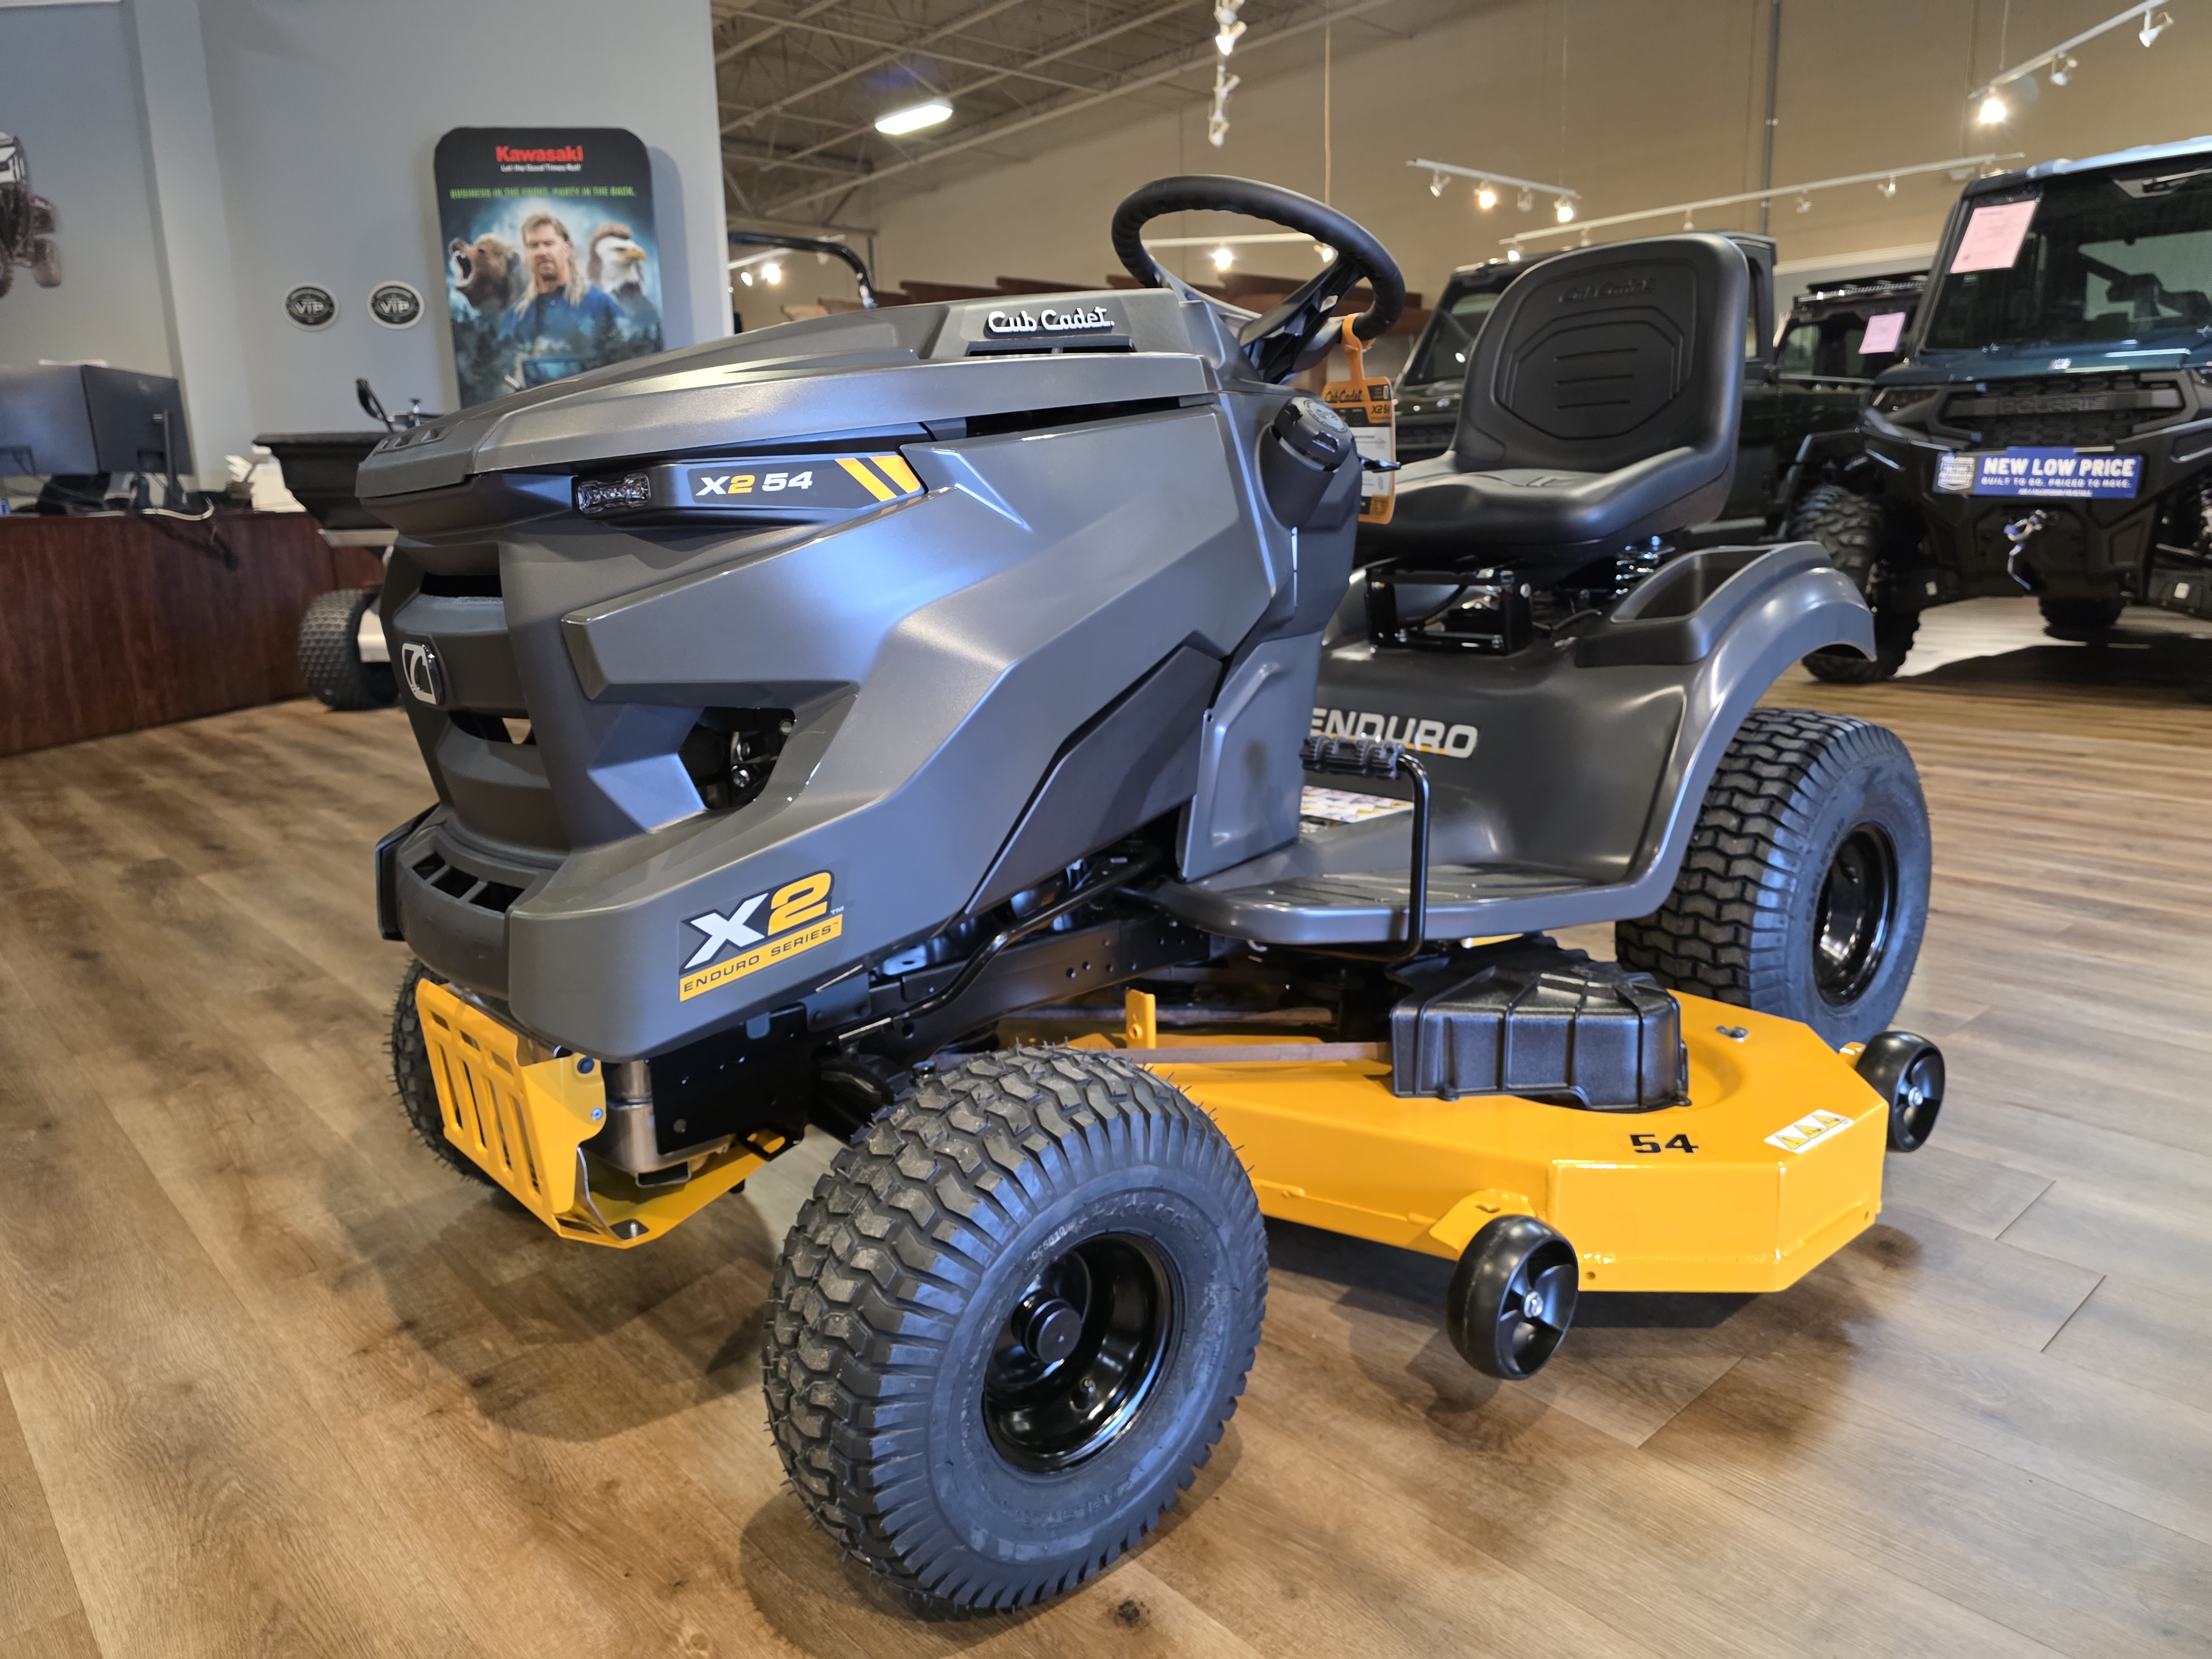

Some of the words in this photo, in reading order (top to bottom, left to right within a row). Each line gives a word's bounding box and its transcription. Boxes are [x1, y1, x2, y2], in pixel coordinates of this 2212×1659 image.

[495, 145, 583, 162] Kawasaki
[295, 301, 325, 315] VIP
[380, 300, 410, 314] VIP
[988, 311, 1037, 333] Cub
[1983, 457, 2028, 476] NEW
[2031, 458, 2076, 476] LOW
[2078, 458, 2136, 477] PRICE
[695, 474, 753, 496] X2
[761, 471, 813, 492] 54
[1980, 477, 2011, 486] BUILT
[2013, 477, 2027, 486] TO
[2048, 478, 2085, 488] PRICED
[2087, 478, 2101, 488] TO
[2102, 479, 2132, 488] MOVE.
[1310, 707, 1478, 759] ENDURO
[685, 872, 832, 969] X2
[684, 954, 760, 993] ENDURO
[770, 924, 832, 957] SERIES
[1629, 1133, 1699, 1154] 54
